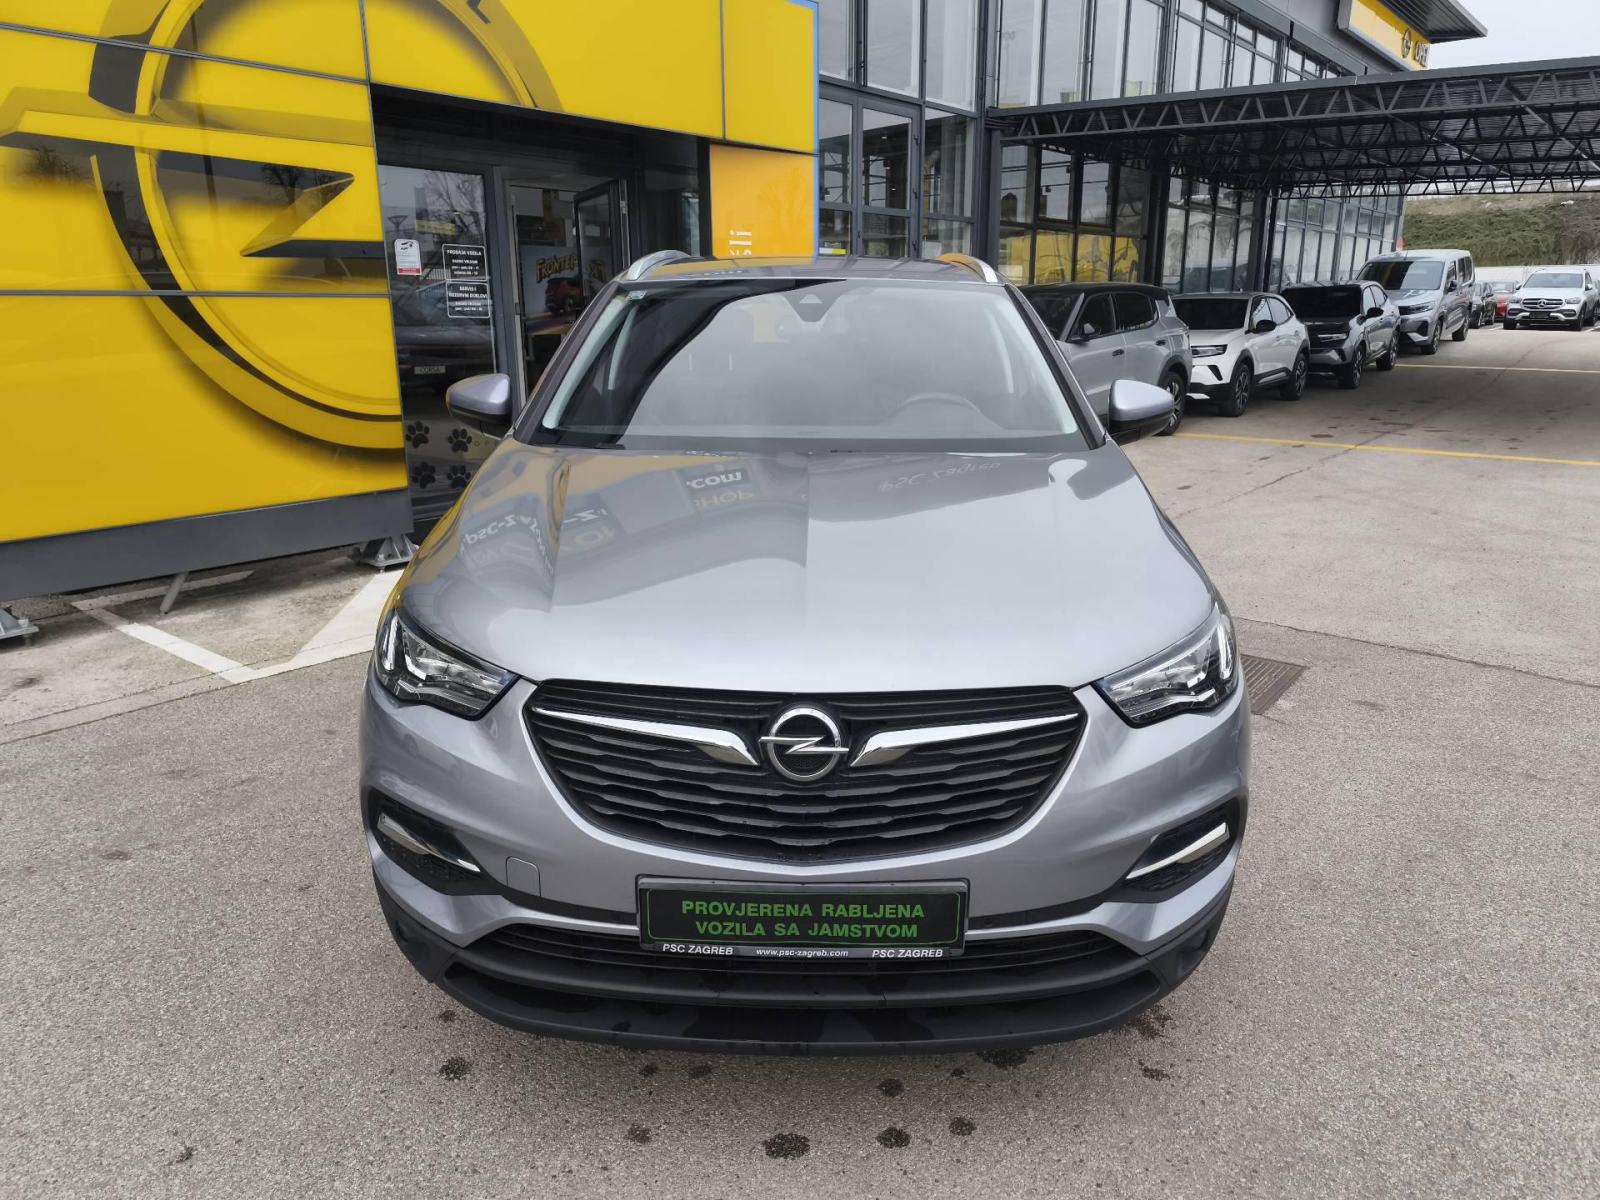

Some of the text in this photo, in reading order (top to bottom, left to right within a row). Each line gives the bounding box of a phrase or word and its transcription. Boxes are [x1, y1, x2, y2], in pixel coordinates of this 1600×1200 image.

[681, 900, 925, 918] PROVJERENA RABLJENA
[695, 920, 918, 938] VOZILA SA JAMSTVOM
[662, 943, 734, 956] PSC ZAGREB
[756, 948, 849, 958] www.psc-zagreb.com
[872, 948, 944, 958] PSC ZAGREB
